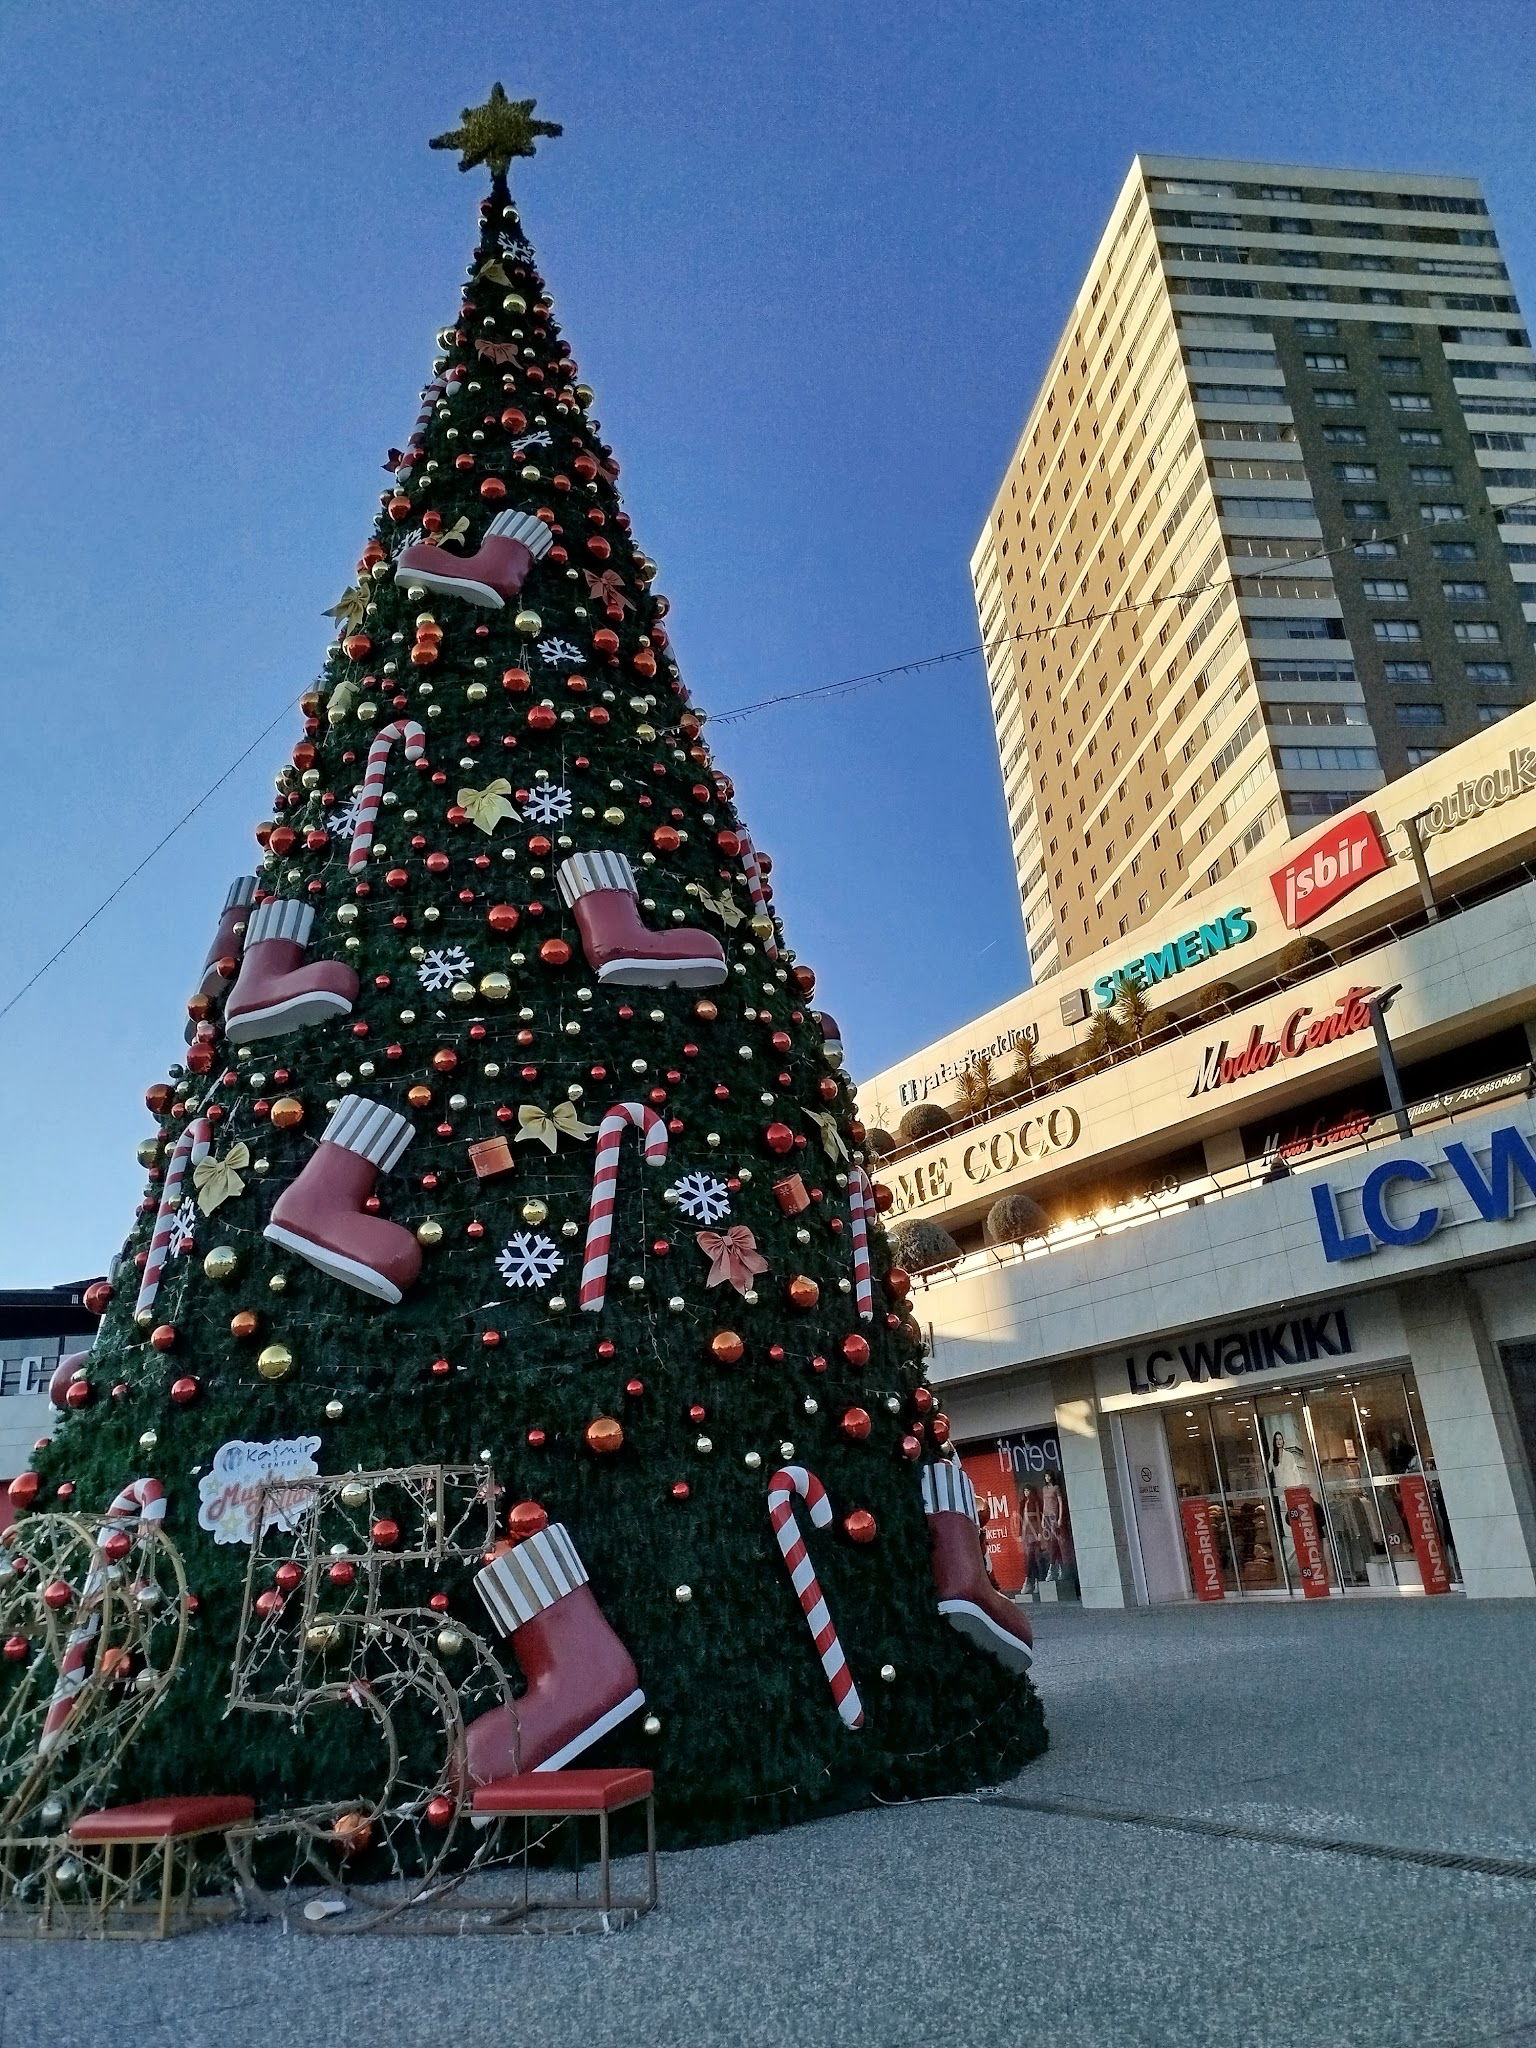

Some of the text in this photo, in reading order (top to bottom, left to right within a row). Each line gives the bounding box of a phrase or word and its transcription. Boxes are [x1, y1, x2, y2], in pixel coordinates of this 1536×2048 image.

[1093, 906, 1256, 1010] SIEMENS
[1187, 1025, 1280, 1098] Moda
[1443, 1093, 1454, 1107] &
[1456, 1071, 1523, 1103] Accessories
[963, 1105, 1082, 1184] COCO
[1126, 1350, 1178, 1396] LC
[260, 1459, 298, 1469] CENTER
